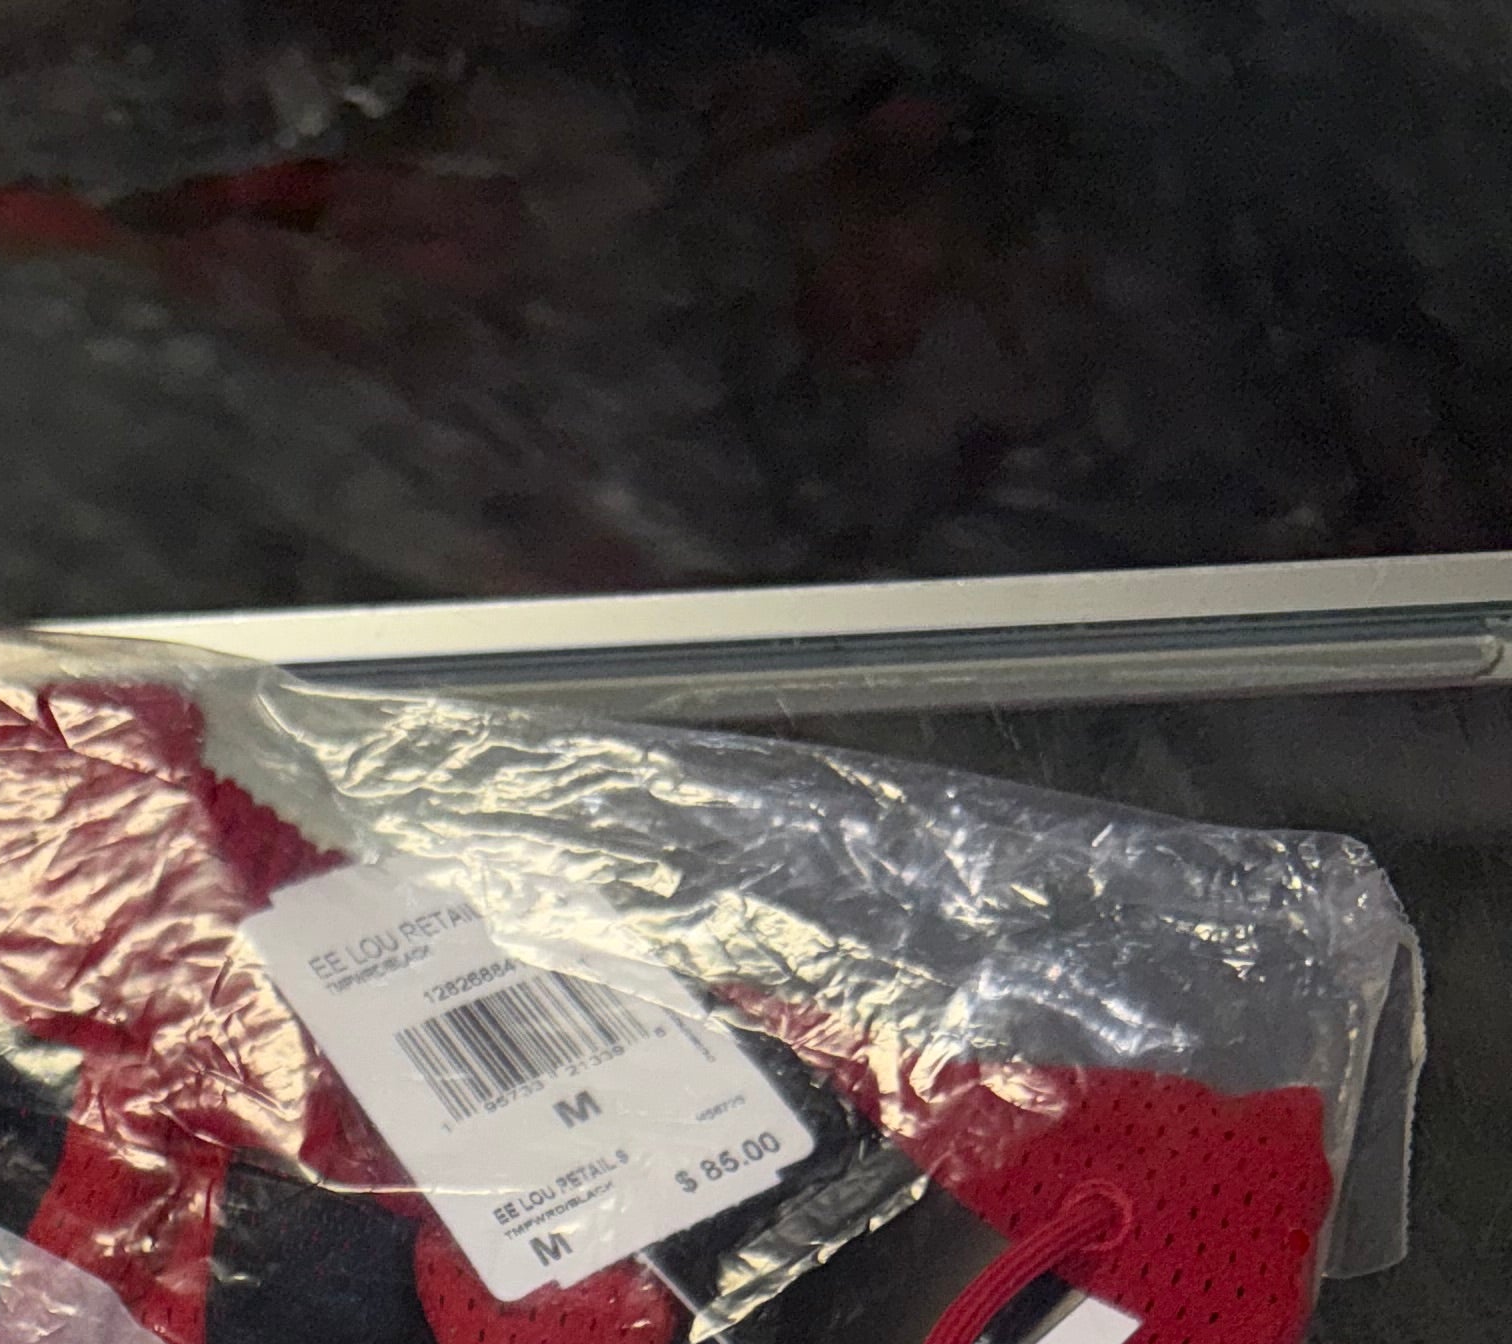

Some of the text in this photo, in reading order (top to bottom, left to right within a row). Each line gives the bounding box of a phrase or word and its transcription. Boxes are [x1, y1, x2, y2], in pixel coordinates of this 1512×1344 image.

[308, 946, 348, 979] EE
[347, 925, 400, 965] LOU
[552, 1090, 602, 1129] M
[700, 1131, 782, 1184] 85.00
[493, 1201, 523, 1226] EE
[520, 1180, 560, 1214] LOU
[529, 1231, 574, 1268] M
